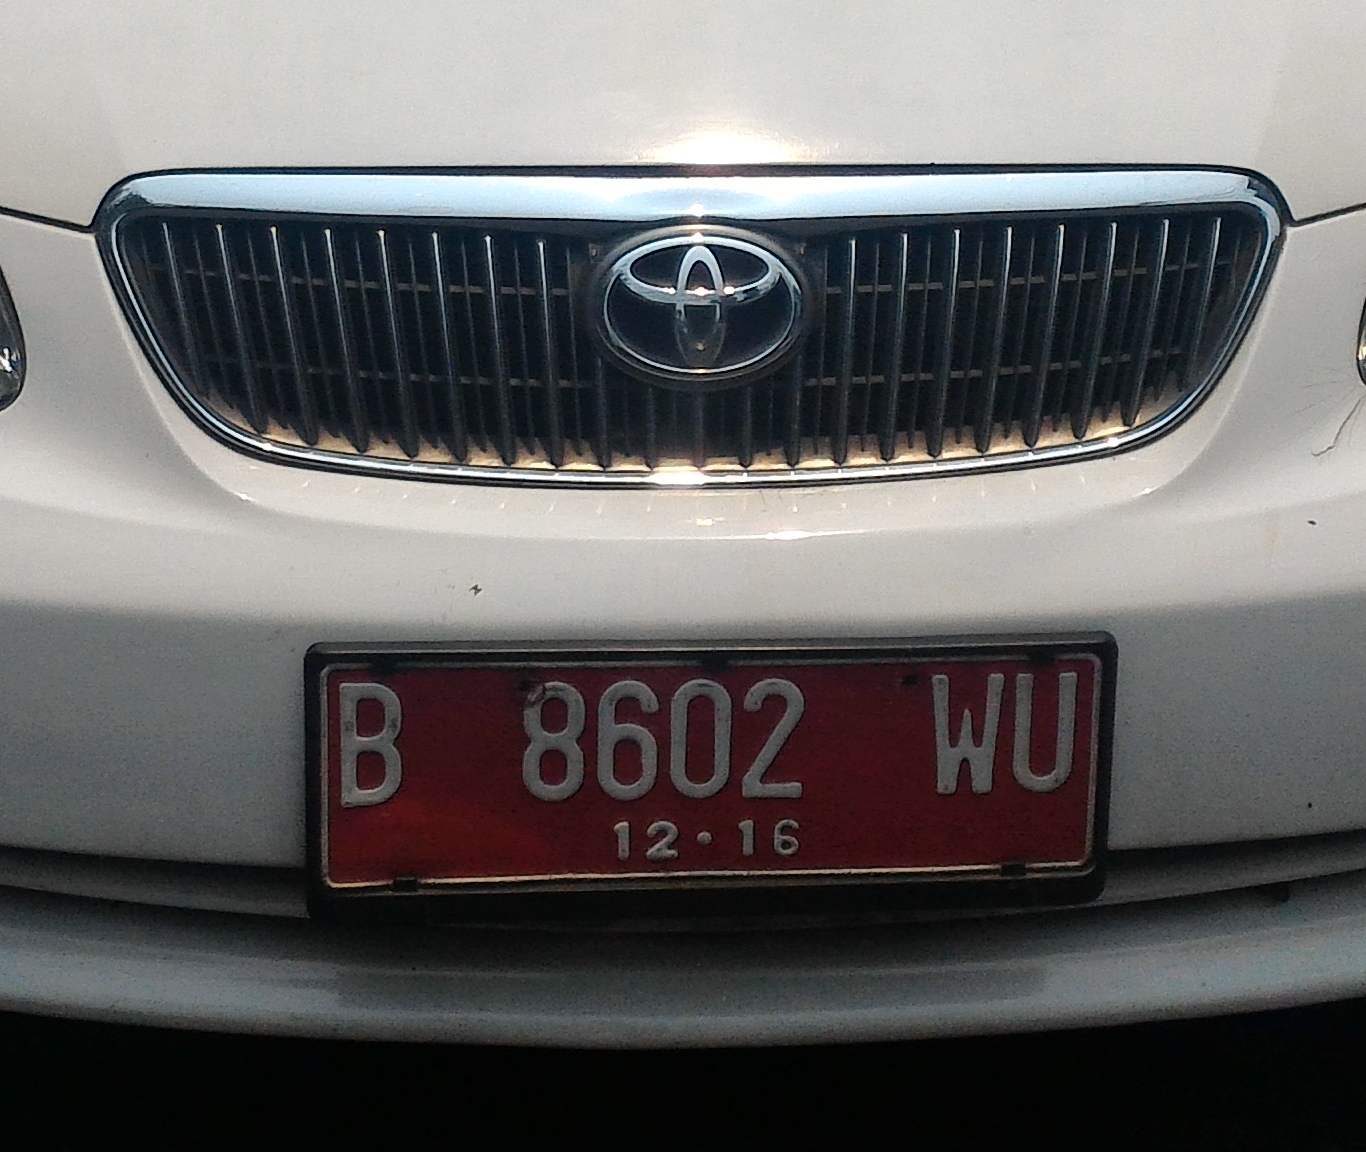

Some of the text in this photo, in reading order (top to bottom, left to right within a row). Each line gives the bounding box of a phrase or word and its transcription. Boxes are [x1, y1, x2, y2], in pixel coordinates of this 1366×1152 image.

[338, 670, 1079, 809] B 8602 WU
